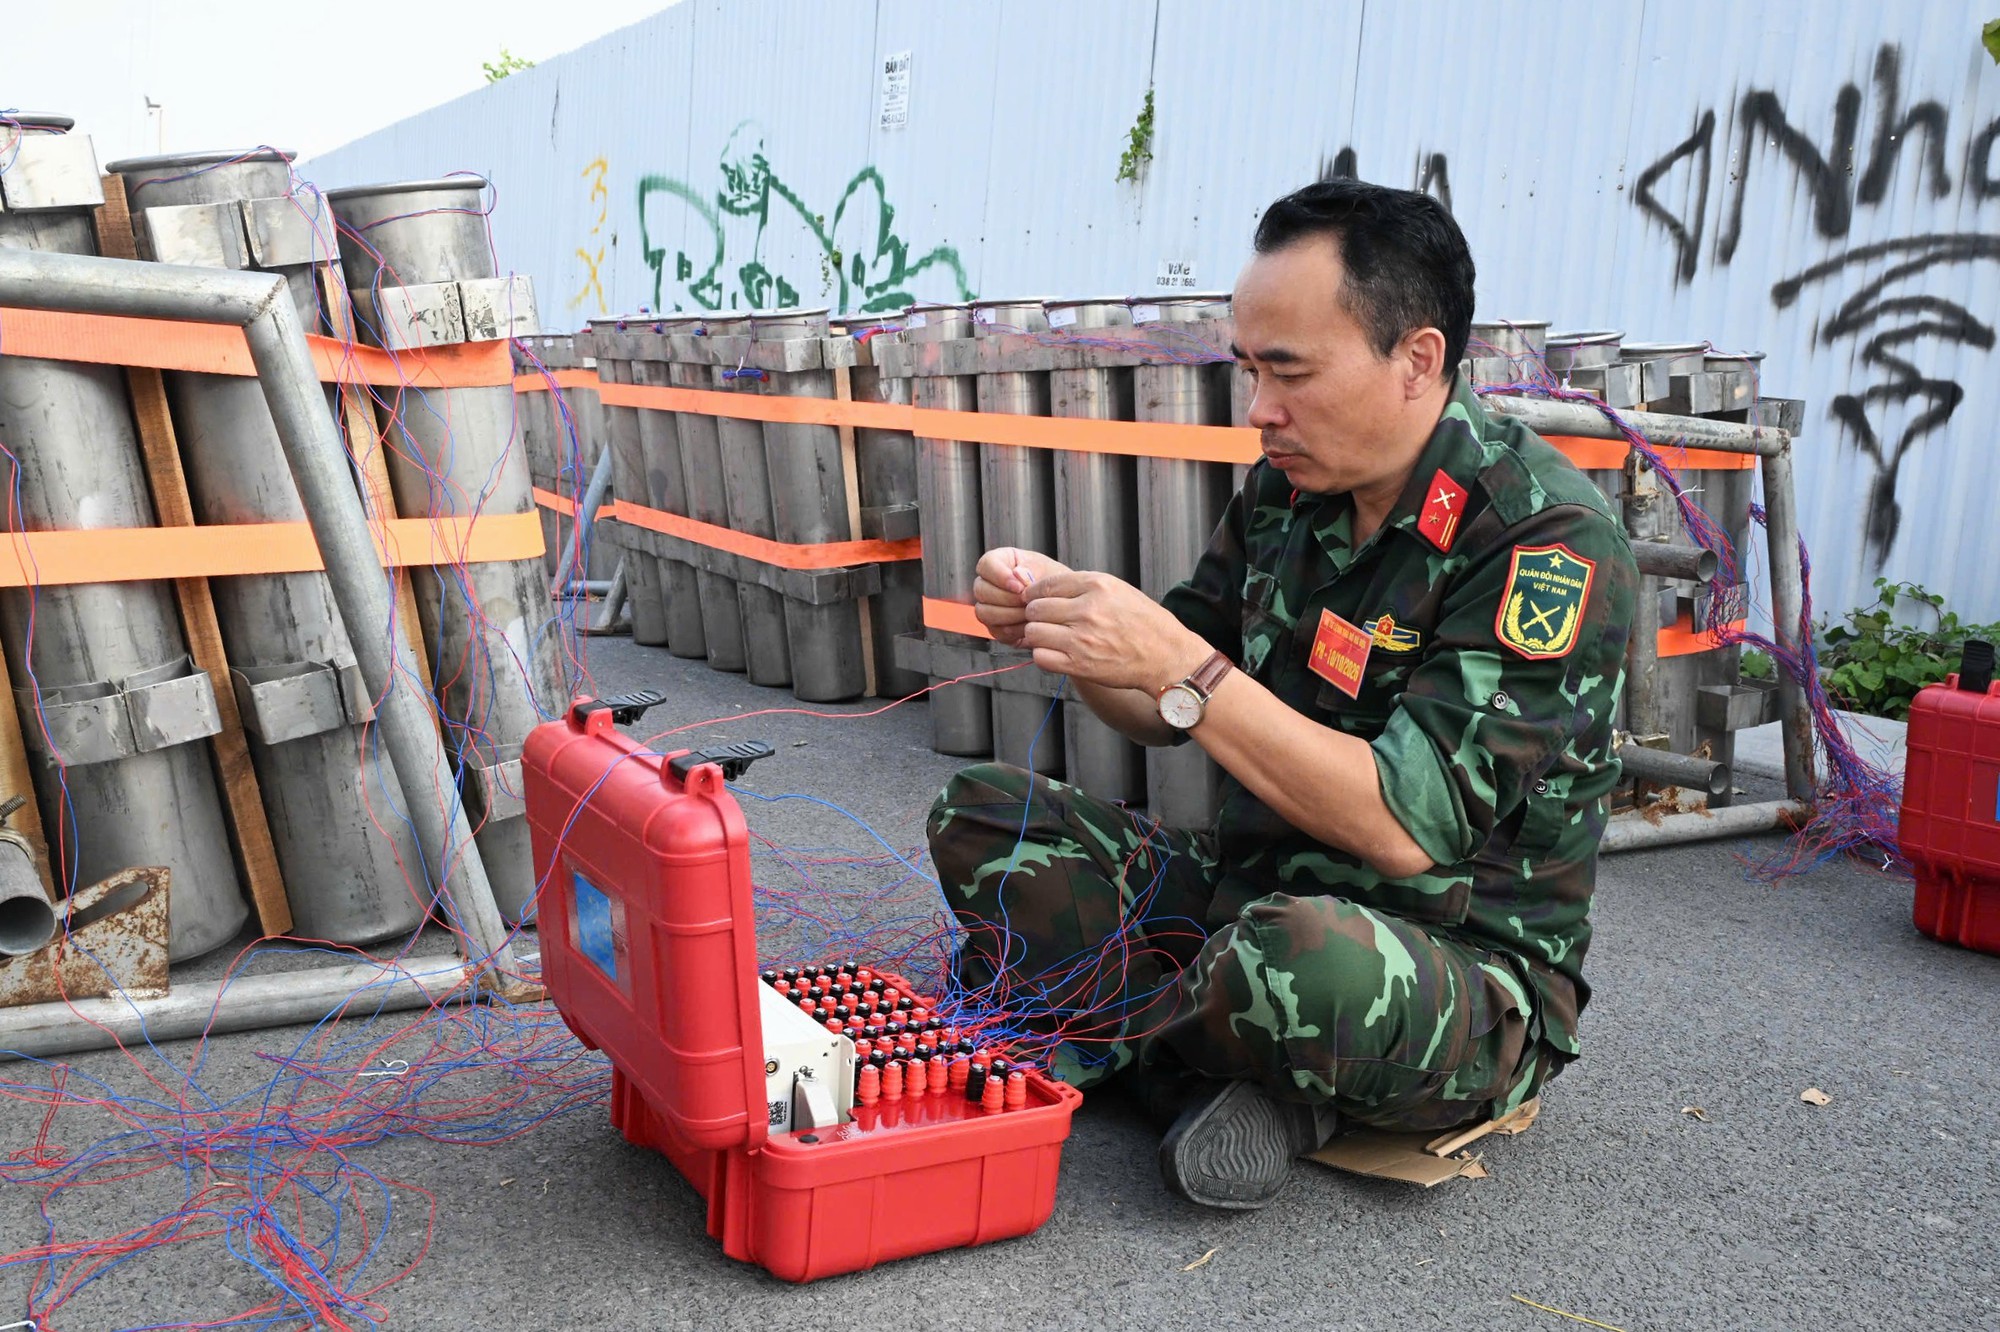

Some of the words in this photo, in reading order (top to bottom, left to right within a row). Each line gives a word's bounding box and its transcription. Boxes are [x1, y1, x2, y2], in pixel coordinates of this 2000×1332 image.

[1519, 568, 1539, 578] QUÂN
[1540, 571, 1552, 581] ĐỘI
[1553, 574, 1570, 585] NHÂN
[1571, 577, 1583, 588] DÂN
[1533, 582, 1550, 592] VIỆT
[1551, 587, 1567, 596] NAM
